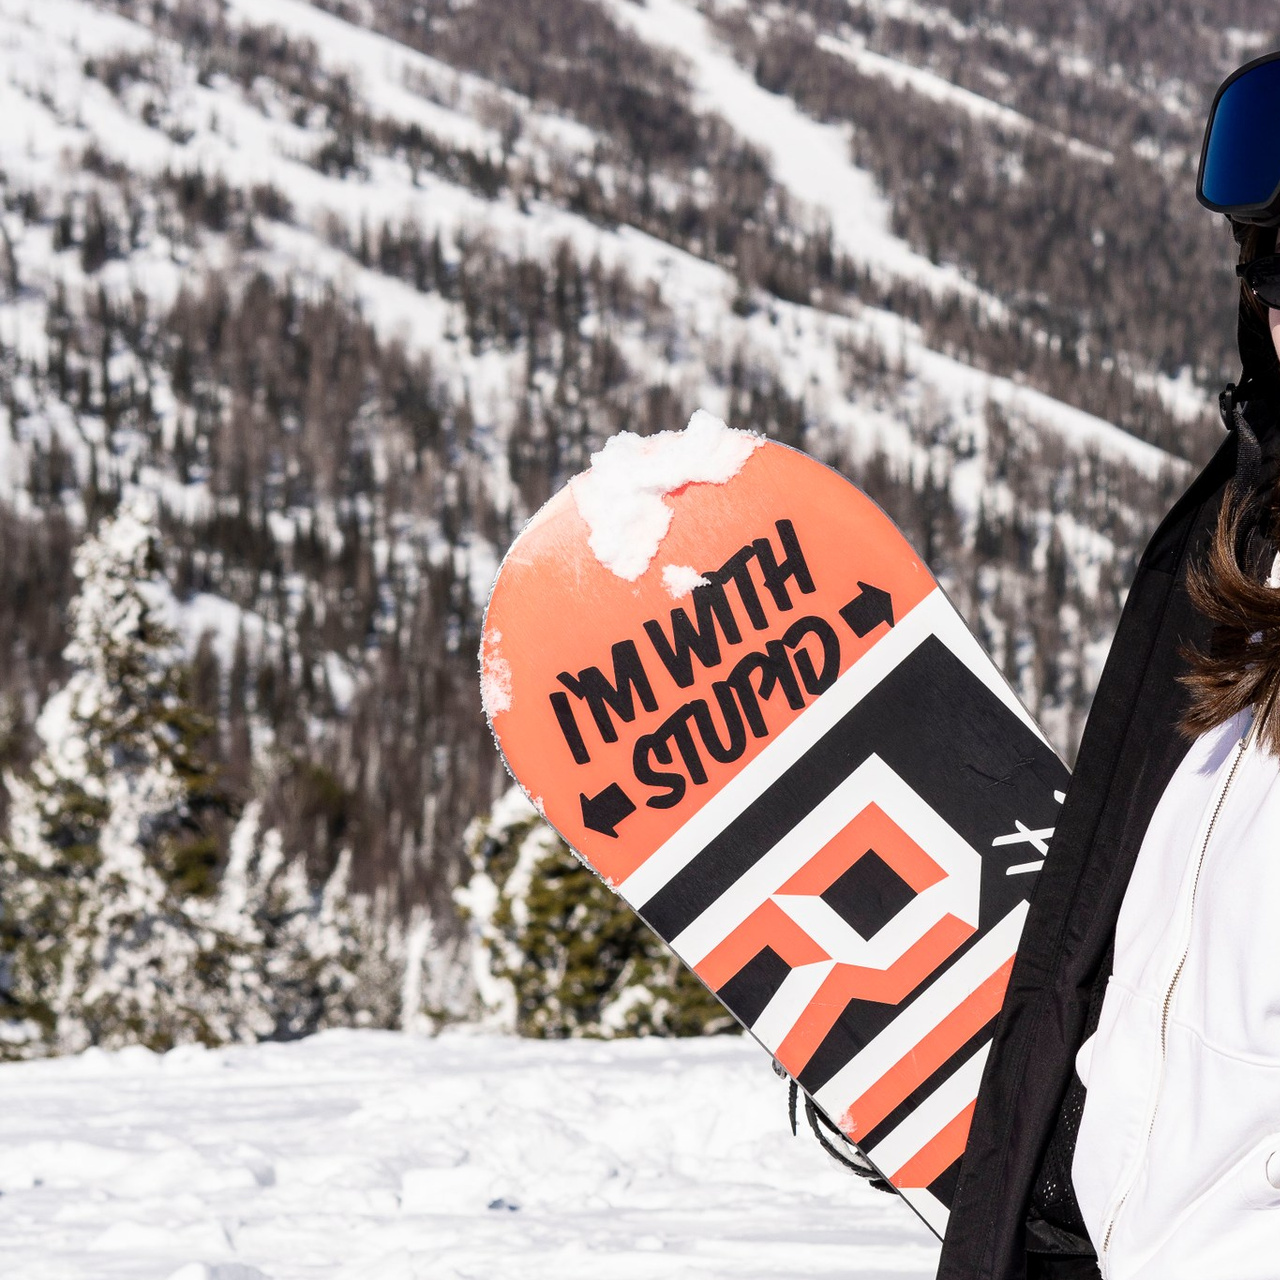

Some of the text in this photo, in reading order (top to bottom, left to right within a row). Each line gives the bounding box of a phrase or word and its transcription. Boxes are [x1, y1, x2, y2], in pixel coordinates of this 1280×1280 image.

[549, 518, 817, 766] I'M WITH
[632, 615, 841, 810] STUPID
